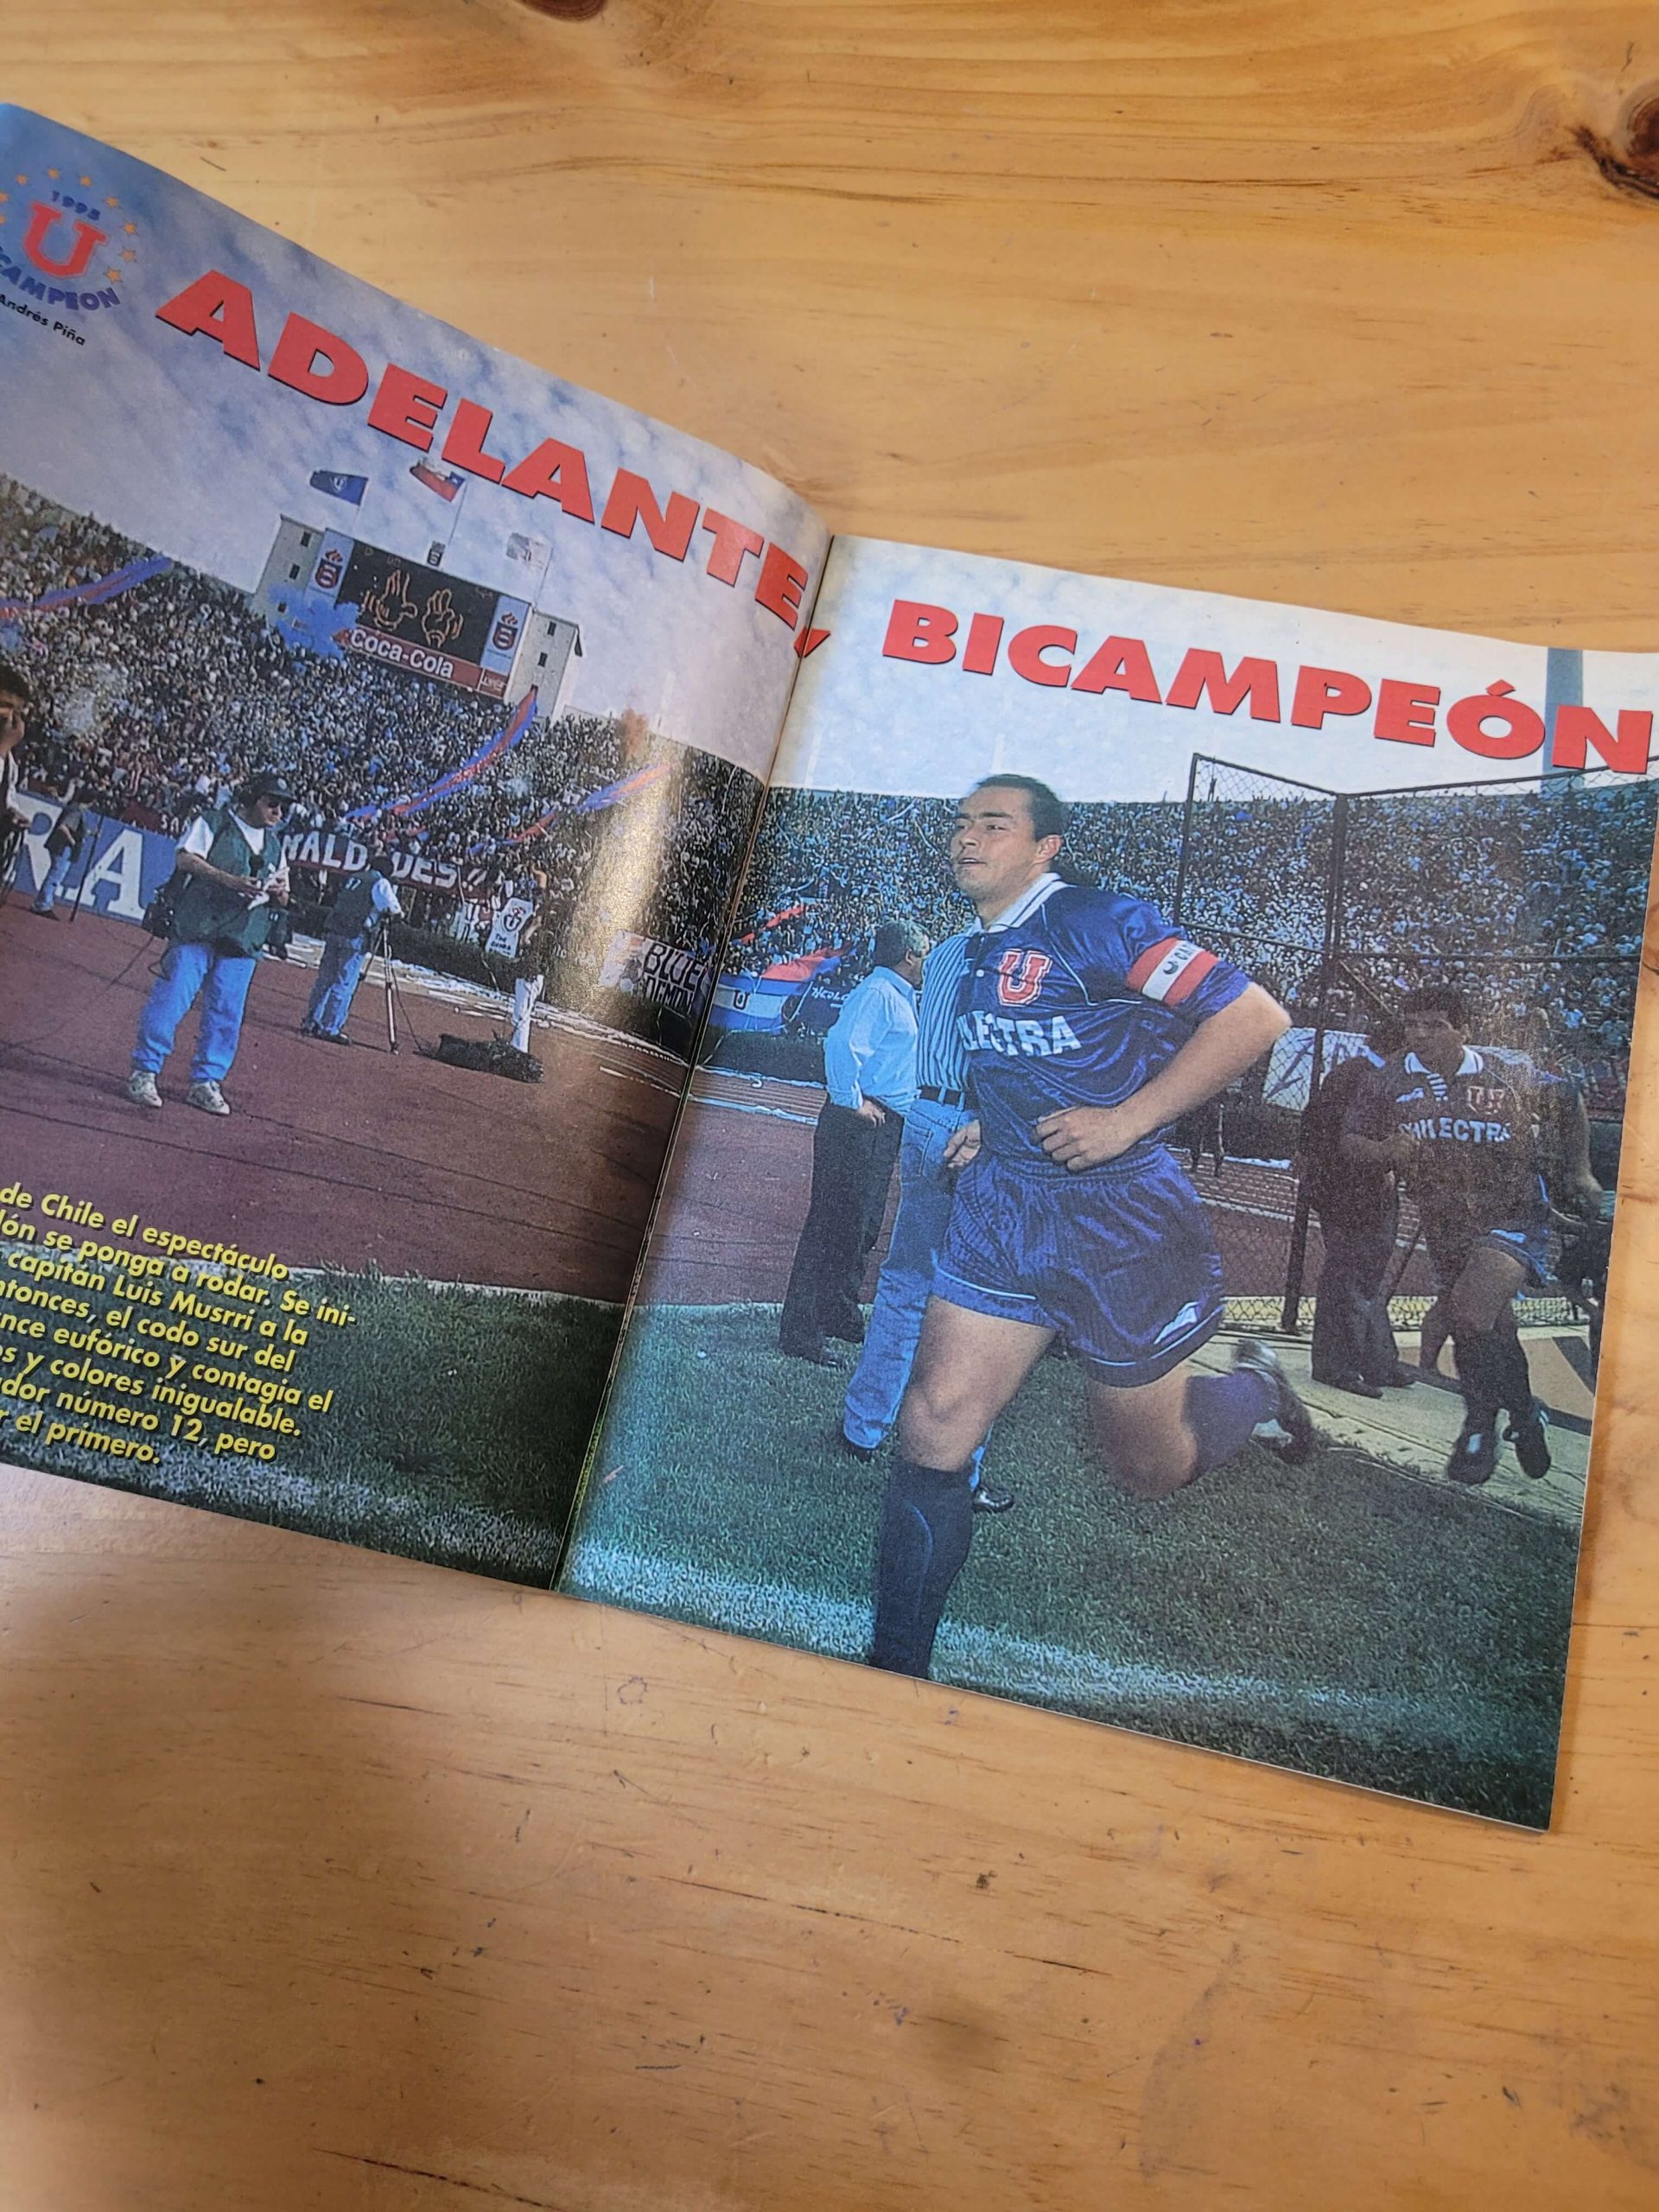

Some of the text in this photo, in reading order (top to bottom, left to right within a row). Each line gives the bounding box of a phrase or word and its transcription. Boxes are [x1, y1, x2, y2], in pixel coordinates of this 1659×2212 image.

[23, 200, 110, 280] U
[54, 322, 86, 346] Piña
[349, 628, 454, 679] Coca-Cola
[881, 599, 1655, 774] BICAMPEÓN
[643, 943, 705, 991] BLUE
[997, 948, 1054, 1007] U
[0, 1182, 289, 1279] de Chile el espectáculo
[8, 1253, 308, 1345] capitán Luis Musrri a la
[43, 1230, 73, 1250] se
[78, 1240, 164, 1277] ponga
[172, 1265, 190, 1282] a
[196, 1273, 270, 1306] rodar.
[280, 1290, 310, 1315] Se
[316, 1298, 355, 1326] ini-
[0, 1312, 334, 1413] nce eufórico y contagia el
[106, 1305, 133, 1328] el
[137, 1319, 200, 1346] codo
[206, 1337, 248, 1358] sur
[254, 1344, 296, 1371] del
[0, 1373, 276, 1459] dor número 12, pero
[23, 1351, 44, 1375] y
[50, 1357, 144, 1395] colores
[151, 1376, 301, 1436] inigualable.
[16, 1410, 43, 1433] el
[45, 1422, 160, 1465] primero.
